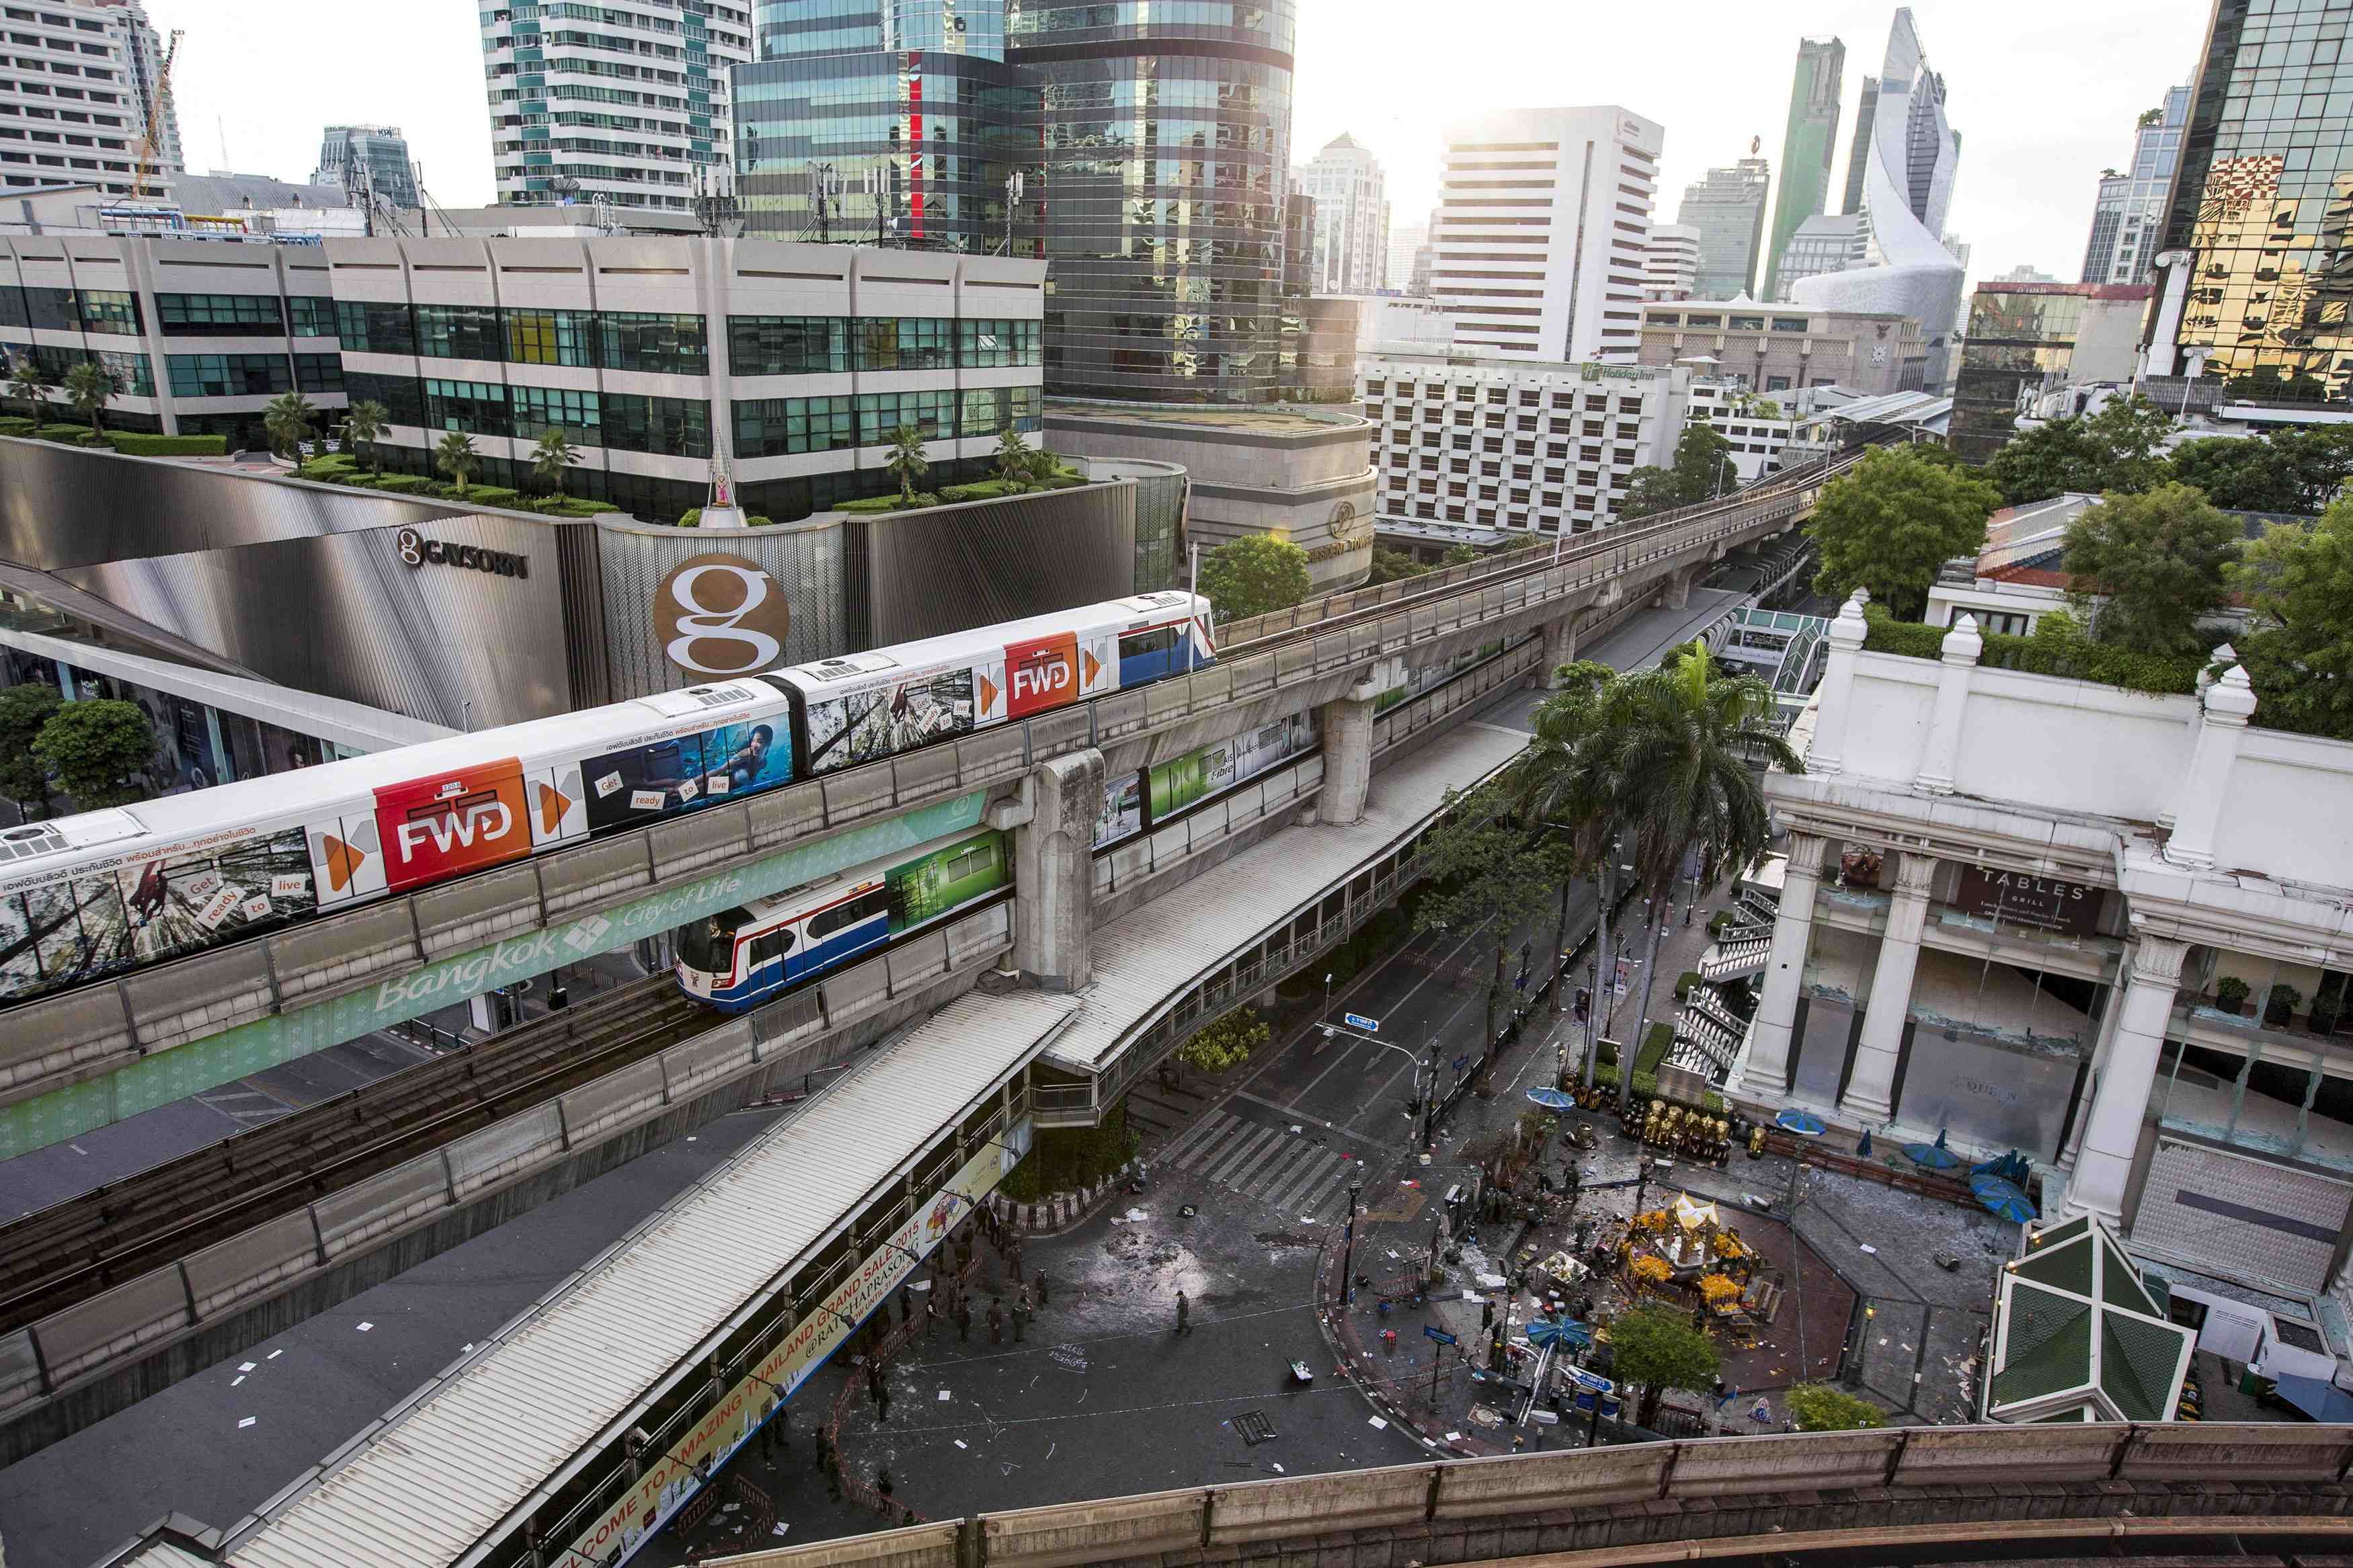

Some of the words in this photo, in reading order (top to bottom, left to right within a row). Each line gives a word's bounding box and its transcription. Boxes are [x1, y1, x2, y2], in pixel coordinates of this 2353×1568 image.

[1602, 368, 1639, 381] Holiday
[1639, 370, 1655, 380] Inn
[424, 540, 529, 579] GAYSORN
[1014, 661, 1070, 700] FWD
[1211, 764, 1234, 781] Fibre
[1224, 753, 1233, 764] AIS
[601, 777, 619, 791] Get
[635, 796, 661, 807] ready
[683, 785, 694, 795] to
[711, 780, 727, 789] live
[397, 801, 513, 864] FWD
[71, 858, 123, 876] ประกันชีวิต
[190, 876, 215, 895] Get
[207, 891, 237, 921] ready
[251, 902, 266, 913] to
[279, 880, 301, 891] live
[1983, 870, 2083, 900] TABLES
[2011, 895, 2044, 907] GRILL
[374, 930, 557, 1012] Bangkok
[623, 902, 667, 925] City
[672, 888, 693, 910] of
[695, 872, 742, 903] Life
[865, 1288, 884, 1311] UNTIL
[892, 1265, 905, 1282] AUG
[641, 1470, 666, 1499] TO
[670, 1394, 743, 1475] AMAZING
[744, 1324, 814, 1397] THAILAND
[817, 1278, 861, 1327] GRAND
[863, 1247, 893, 1282] SALE
[895, 1221, 920, 1252] 2015
